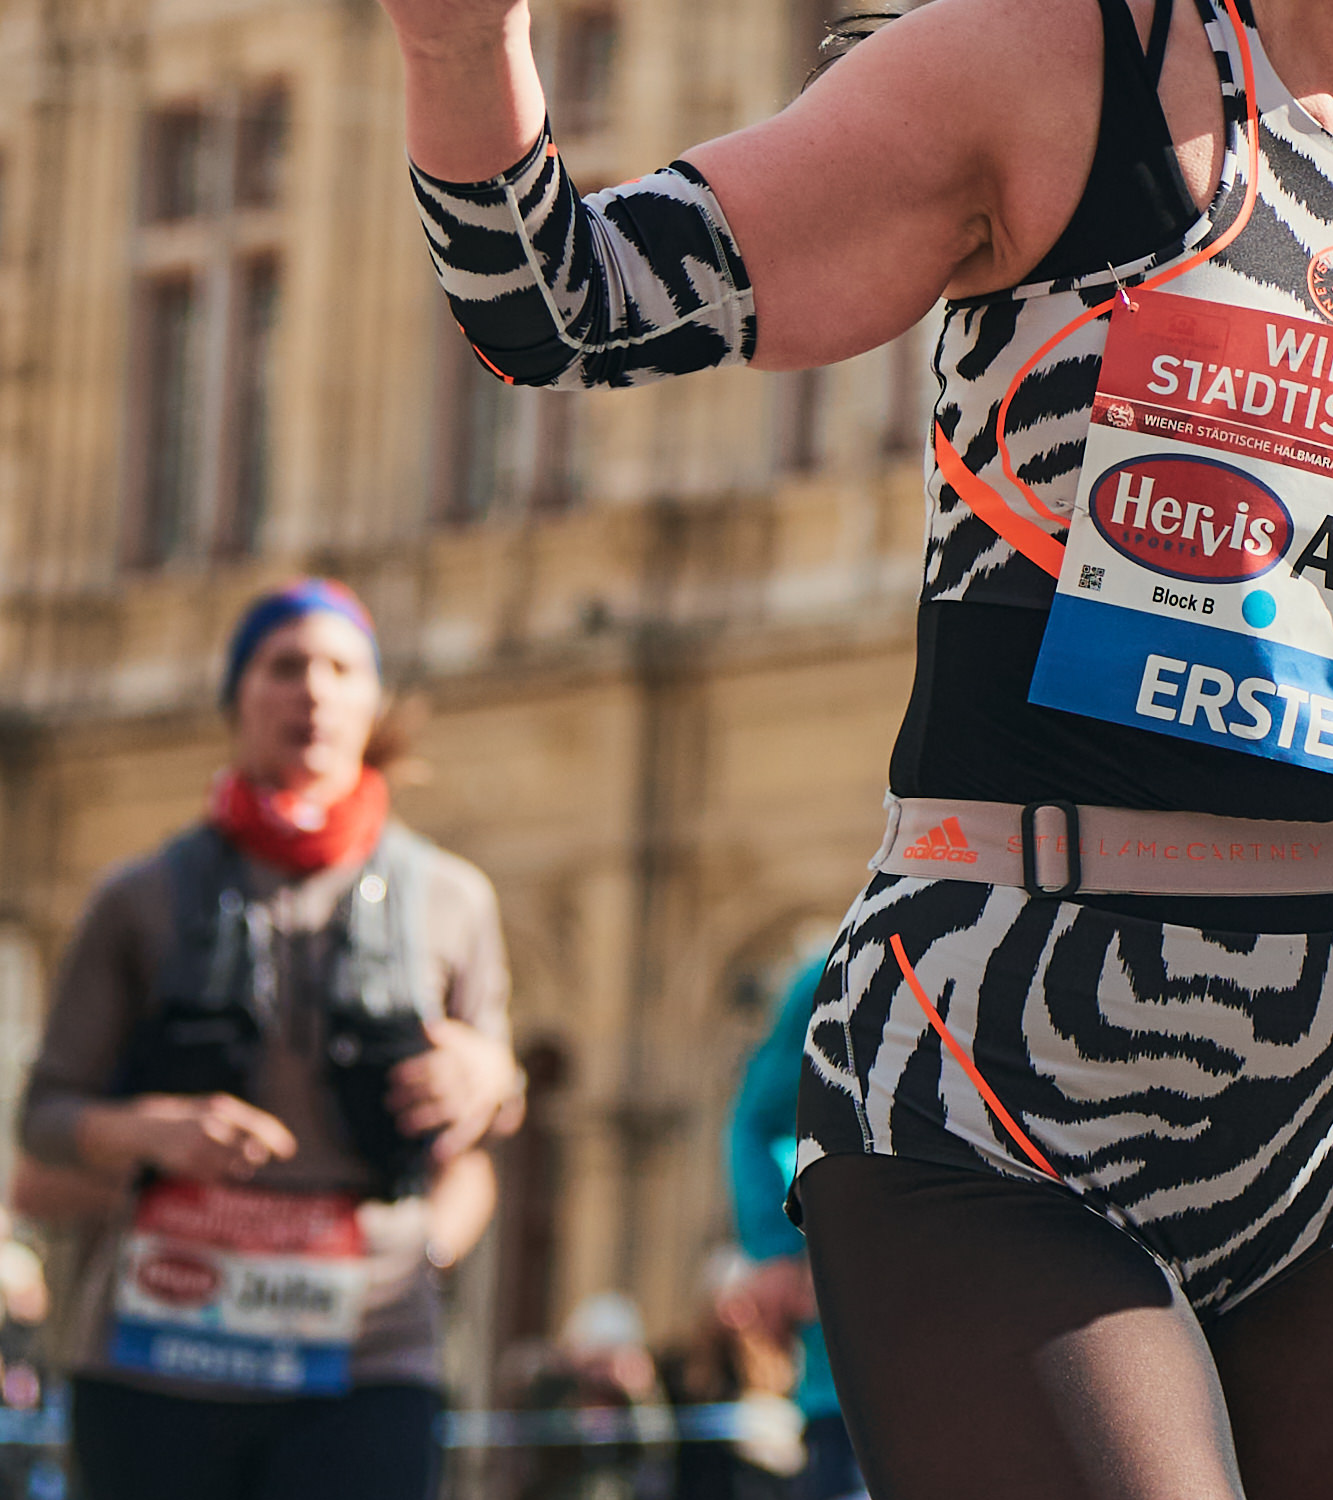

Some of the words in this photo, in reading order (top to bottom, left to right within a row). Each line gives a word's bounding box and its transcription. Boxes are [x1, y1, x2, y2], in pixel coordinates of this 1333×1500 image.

[1144, 414, 1193, 435] WIENER
[1196, 426, 1271, 452] STÄDTISCHE
[1111, 471, 1276, 557] Hervis
[1122, 531, 1199, 558] SPORTS
[1152, 586, 1197, 612] Block
[1202, 597, 1215, 615] B
[903, 846, 978, 865] adidas
